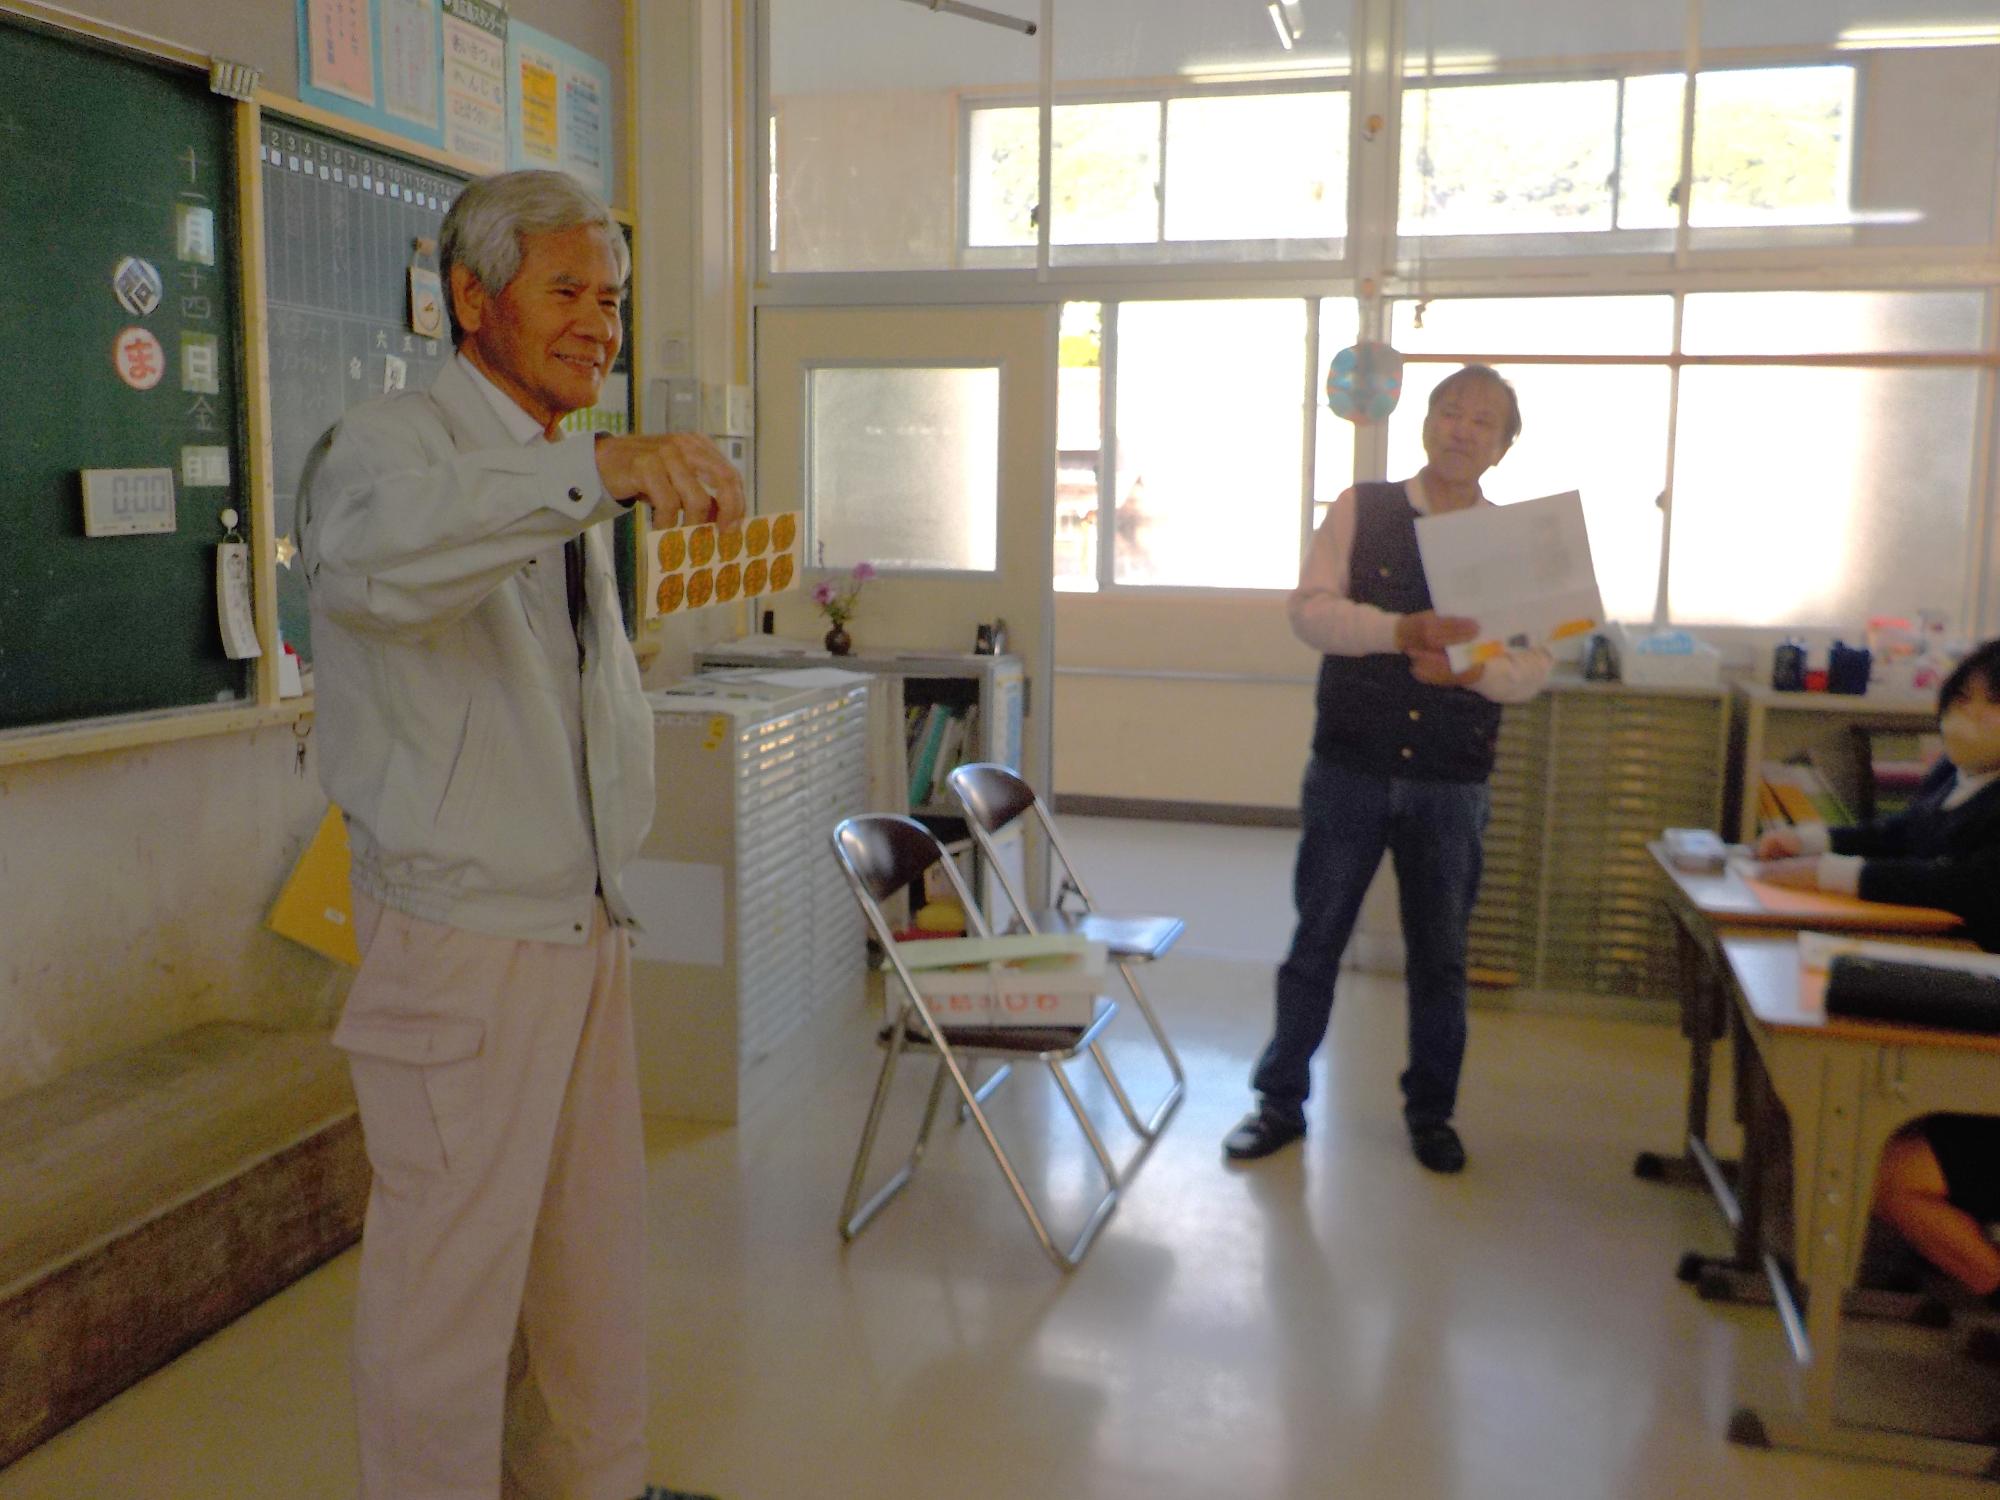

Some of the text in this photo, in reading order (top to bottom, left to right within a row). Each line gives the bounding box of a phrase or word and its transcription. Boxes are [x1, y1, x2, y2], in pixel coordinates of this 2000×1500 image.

[271, 131, 279, 146] 2
[288, 136, 296, 151] 3
[304, 142, 312, 155] 4
[320, 146, 328, 160] 5
[349, 155, 357, 168] 7
